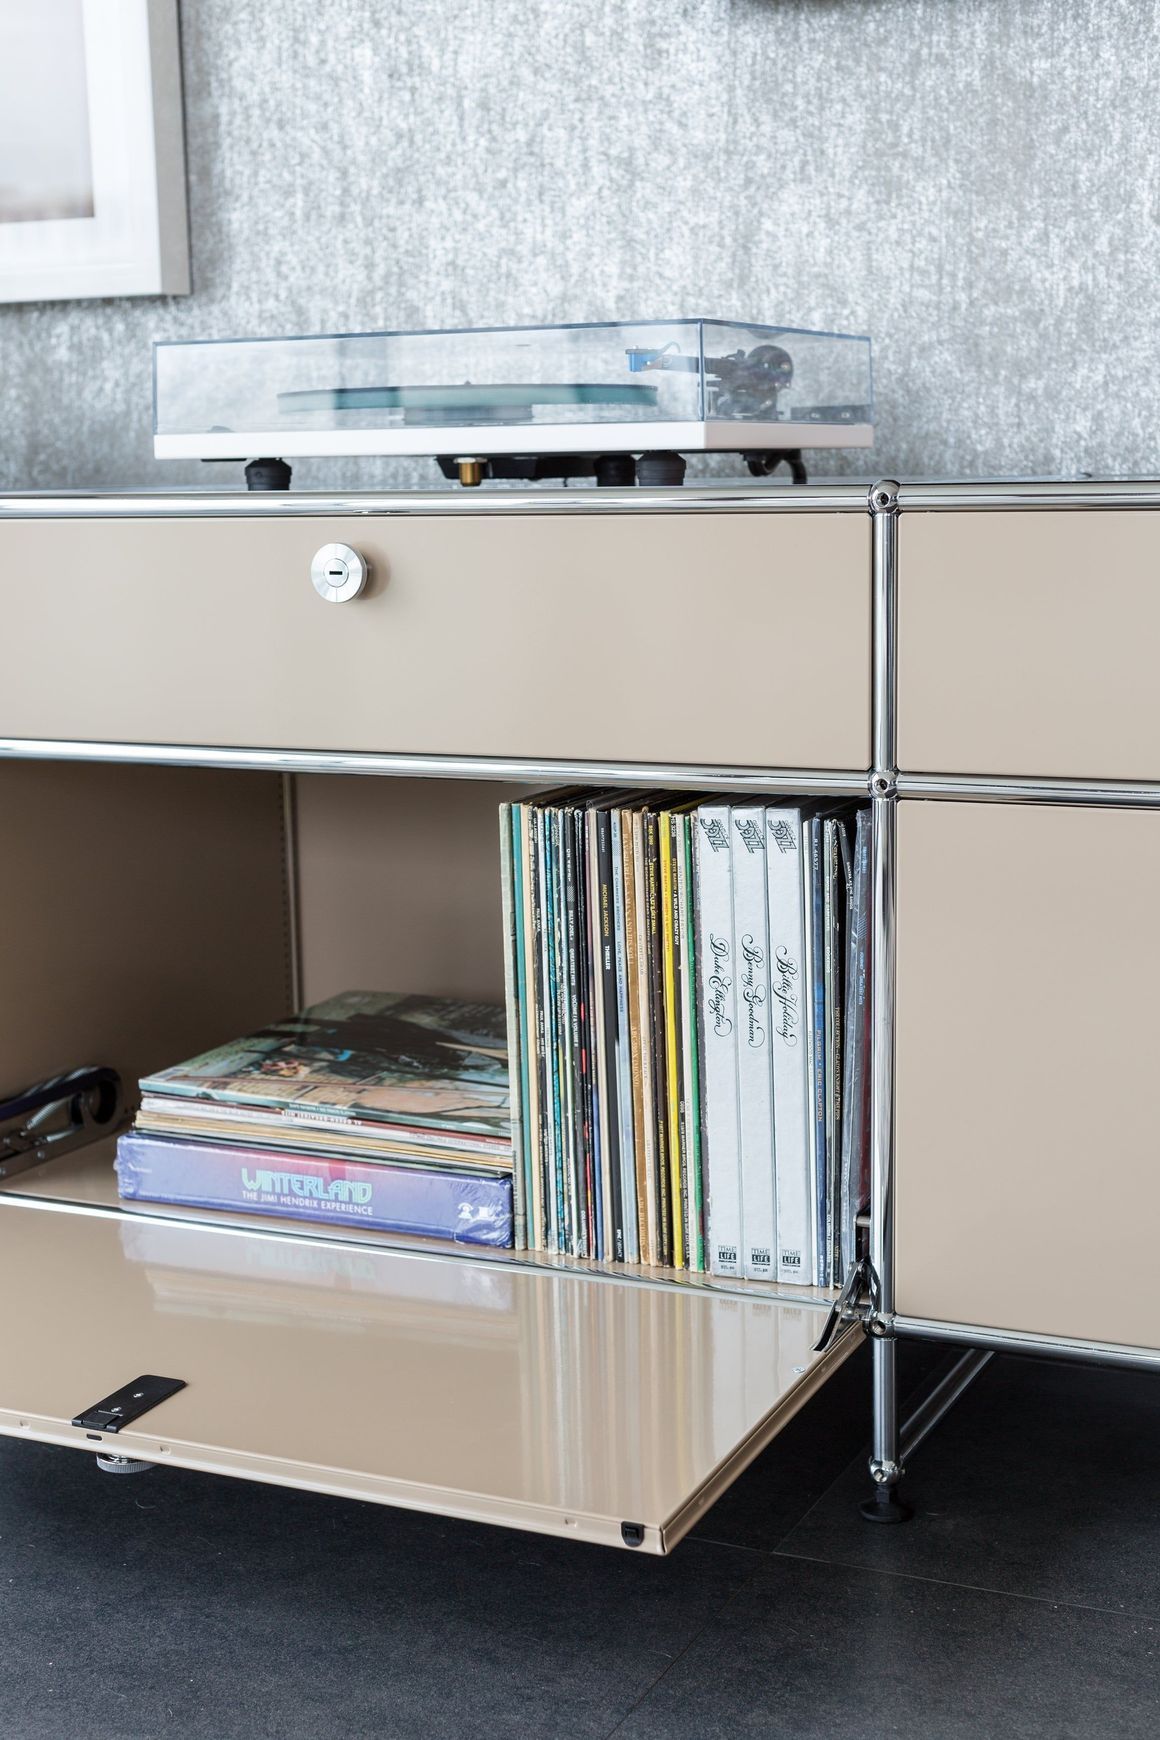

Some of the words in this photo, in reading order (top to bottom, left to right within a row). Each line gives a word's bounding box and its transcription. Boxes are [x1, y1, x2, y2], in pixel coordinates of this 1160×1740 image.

[710, 934, 729, 976] Duke
[742, 934, 765, 986] Benny
[776, 946, 798, 996] Billie
[708, 976, 732, 1037] Ellington
[743, 983, 766, 1048] Goodman
[772, 982, 798, 1046] Holiday
[242, 1167, 372, 1204] WINTERLAND
[242, 1190, 258, 1200] THE
[260, 1194, 277, 1202] JIMI
[280, 1196, 318, 1208] HENDRIX
[321, 1200, 373, 1216] EXPERIENCE
[719, 1252, 736, 1260] LIFE
[752, 1254, 770, 1263] LIFE
[782, 1256, 800, 1264] LIFE
